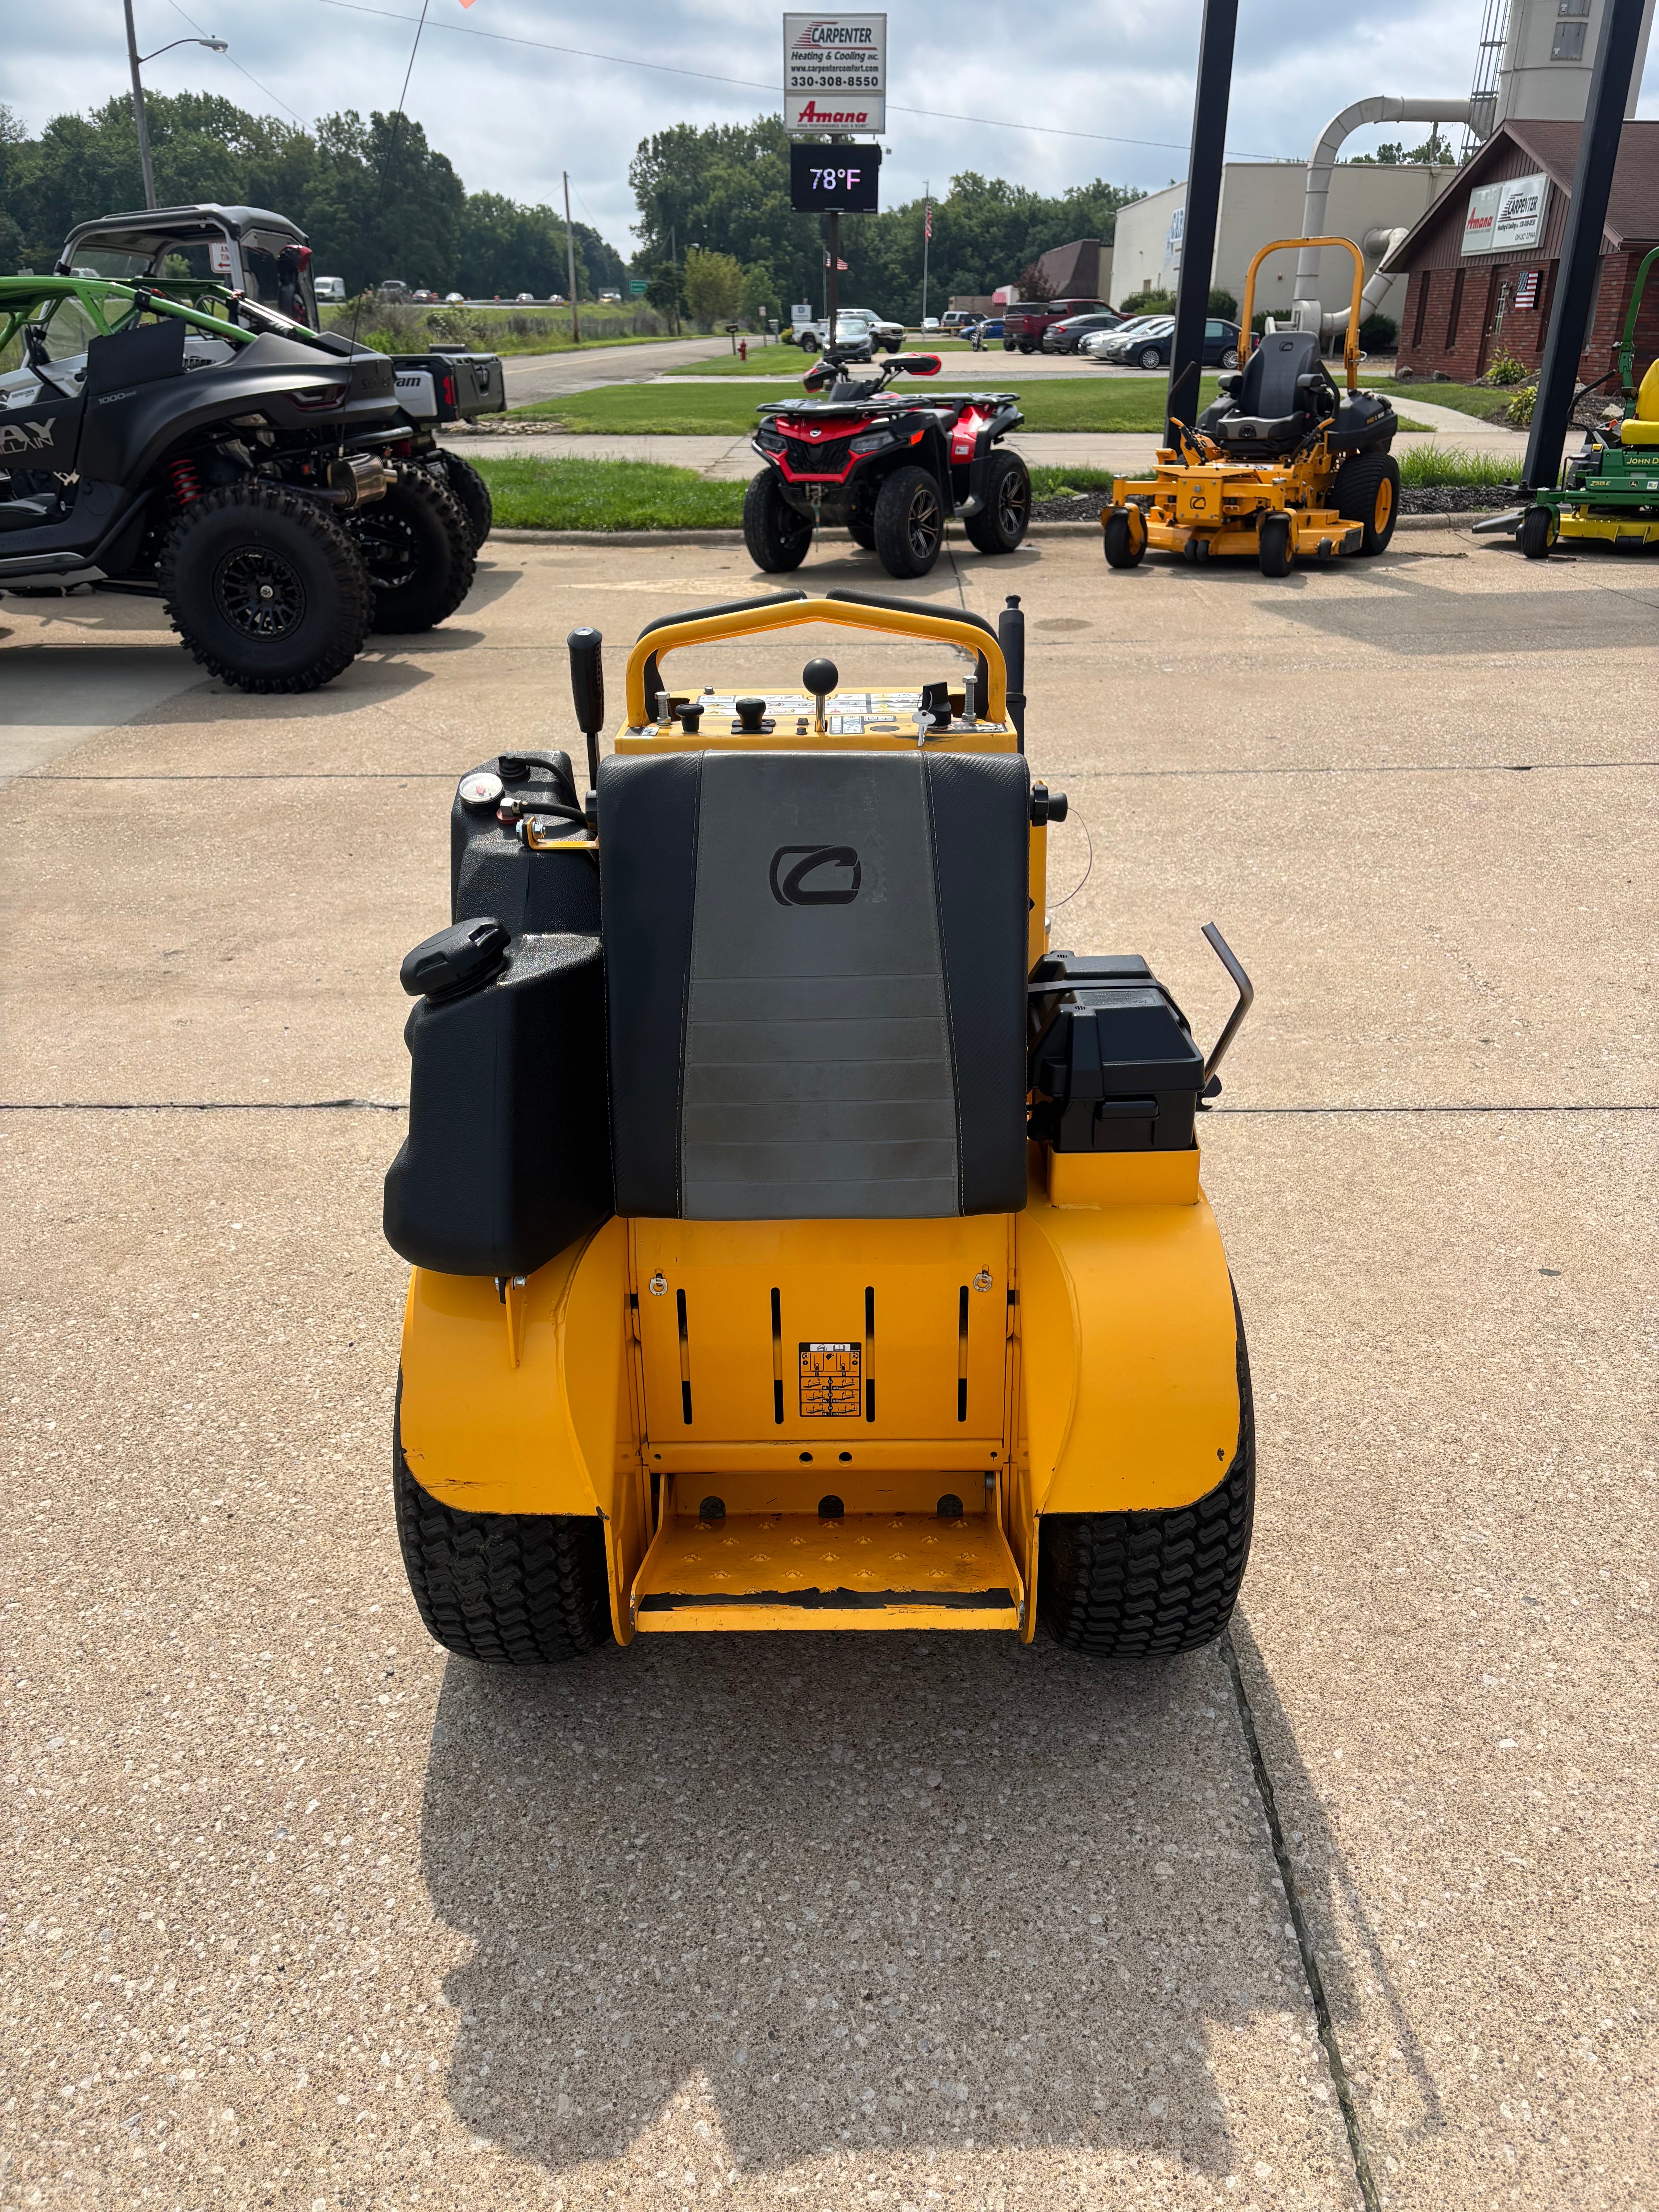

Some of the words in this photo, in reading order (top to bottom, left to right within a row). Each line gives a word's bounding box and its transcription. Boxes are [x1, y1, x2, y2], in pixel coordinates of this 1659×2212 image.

[812, 27, 871, 43] CARPENTER
[791, 51, 823, 62] Heating
[826, 52, 832, 60] &
[835, 51, 866, 62] Cooling
[791, 65, 879, 73] www.carpentercomfort.com
[797, 101, 869, 122] Amana
[810, 169, 861, 190] 78°F
[1507, 196, 1538, 215] CARPENTER
[1466, 206, 1494, 230] Amana
